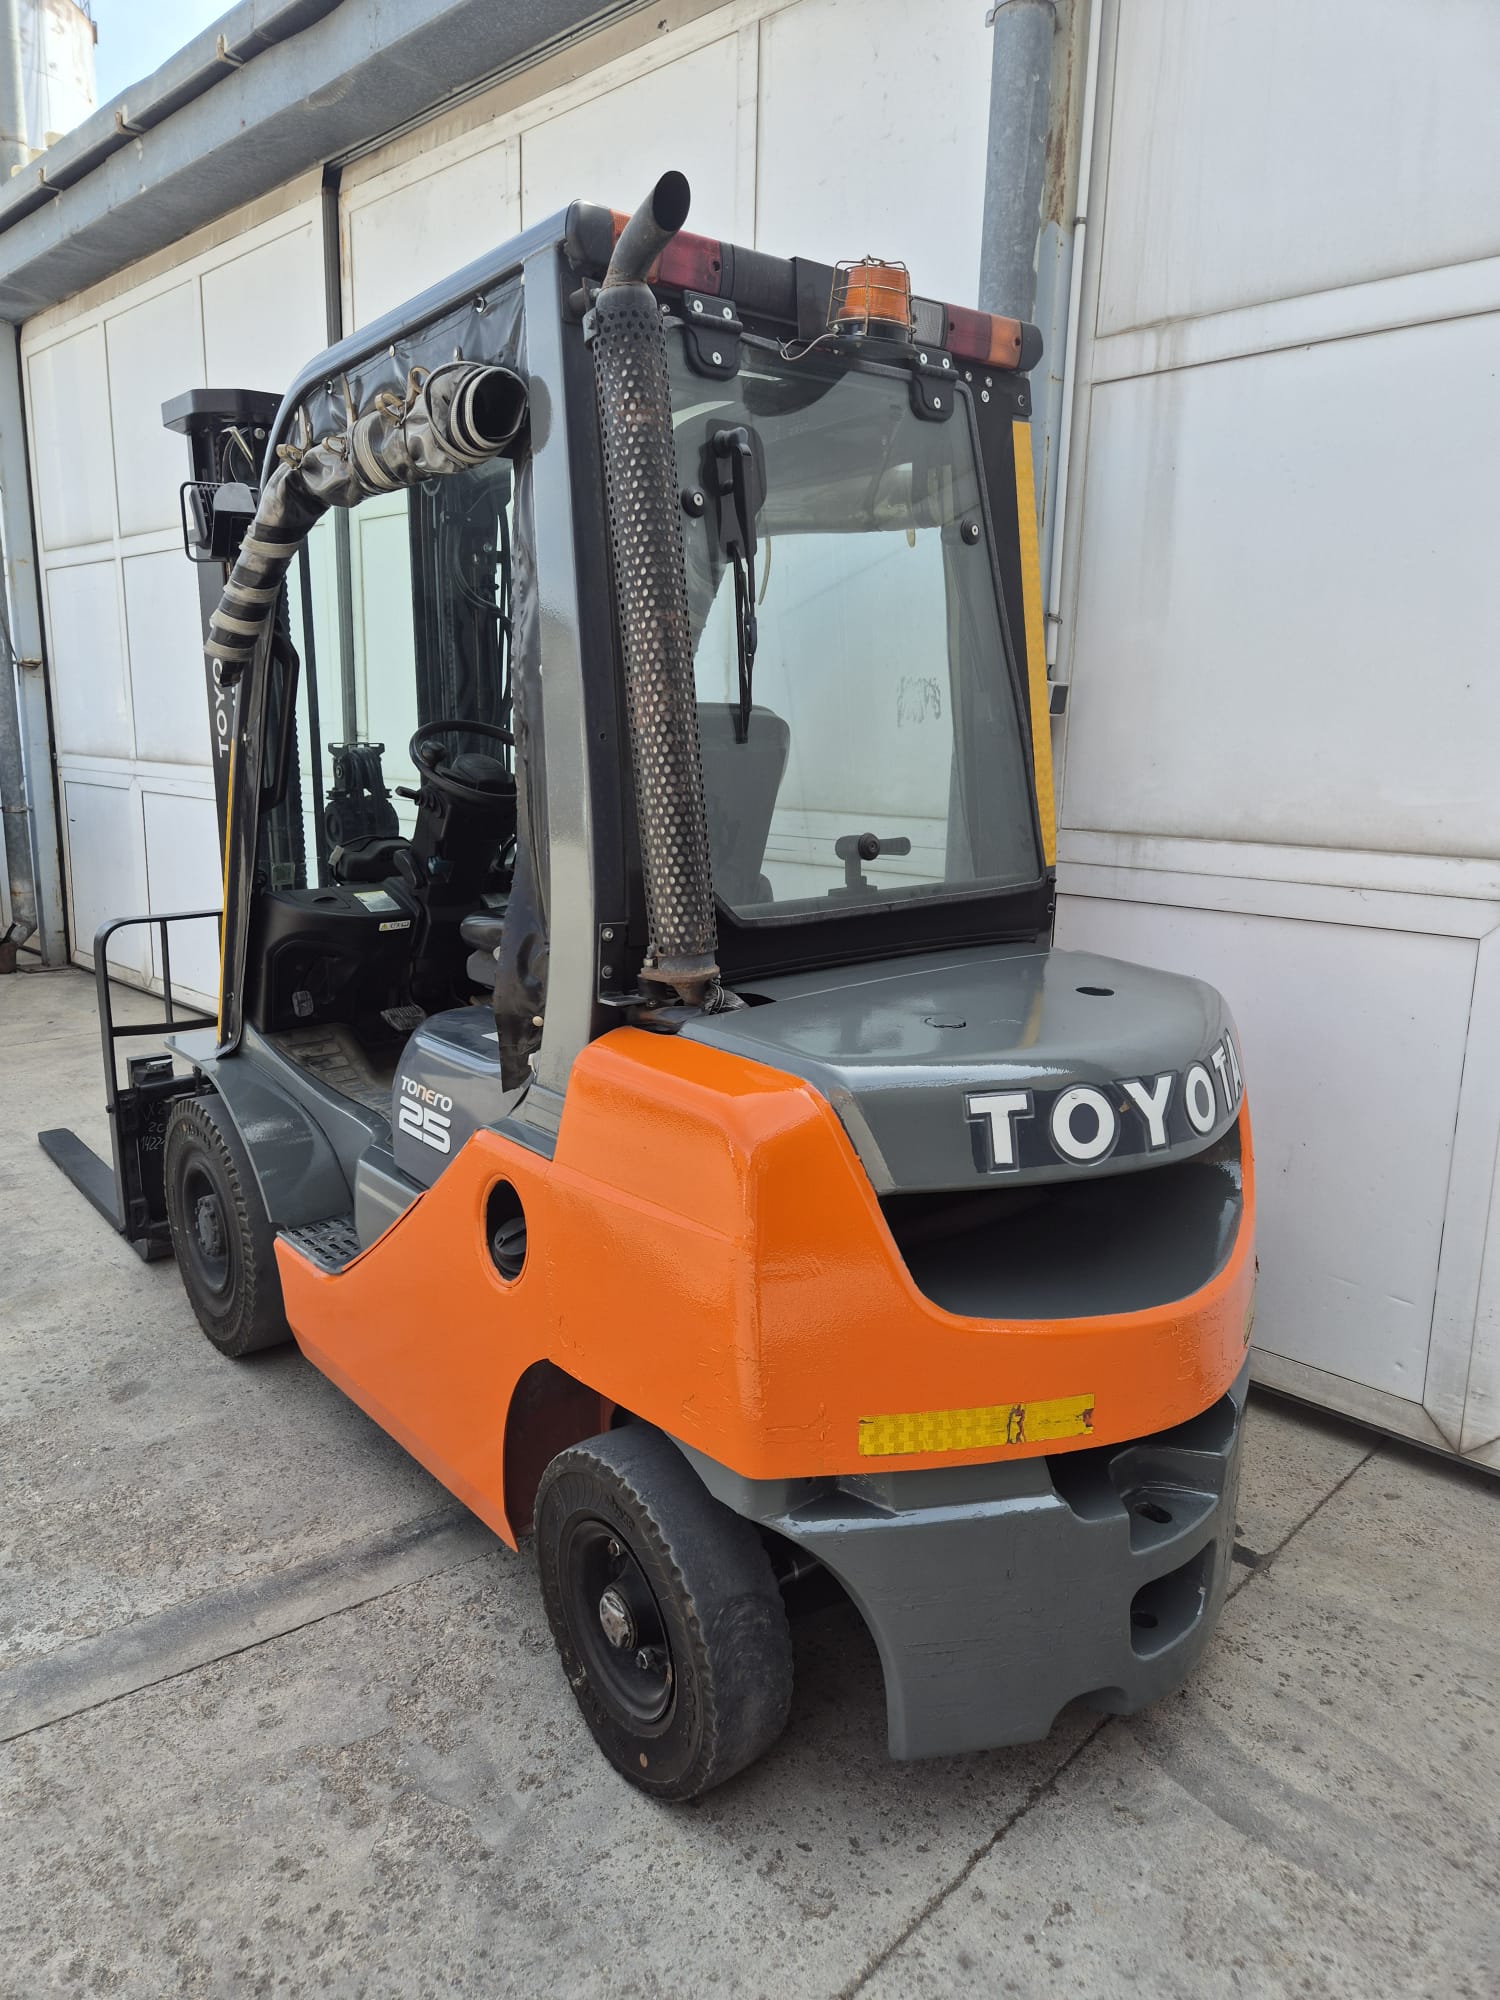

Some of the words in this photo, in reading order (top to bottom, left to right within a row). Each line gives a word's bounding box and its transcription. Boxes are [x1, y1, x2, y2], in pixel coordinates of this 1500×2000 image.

[212, 658, 230, 758] TOYO
[399, 1095, 451, 1154] 25
[966, 1029, 1243, 1172] TOYOTA
